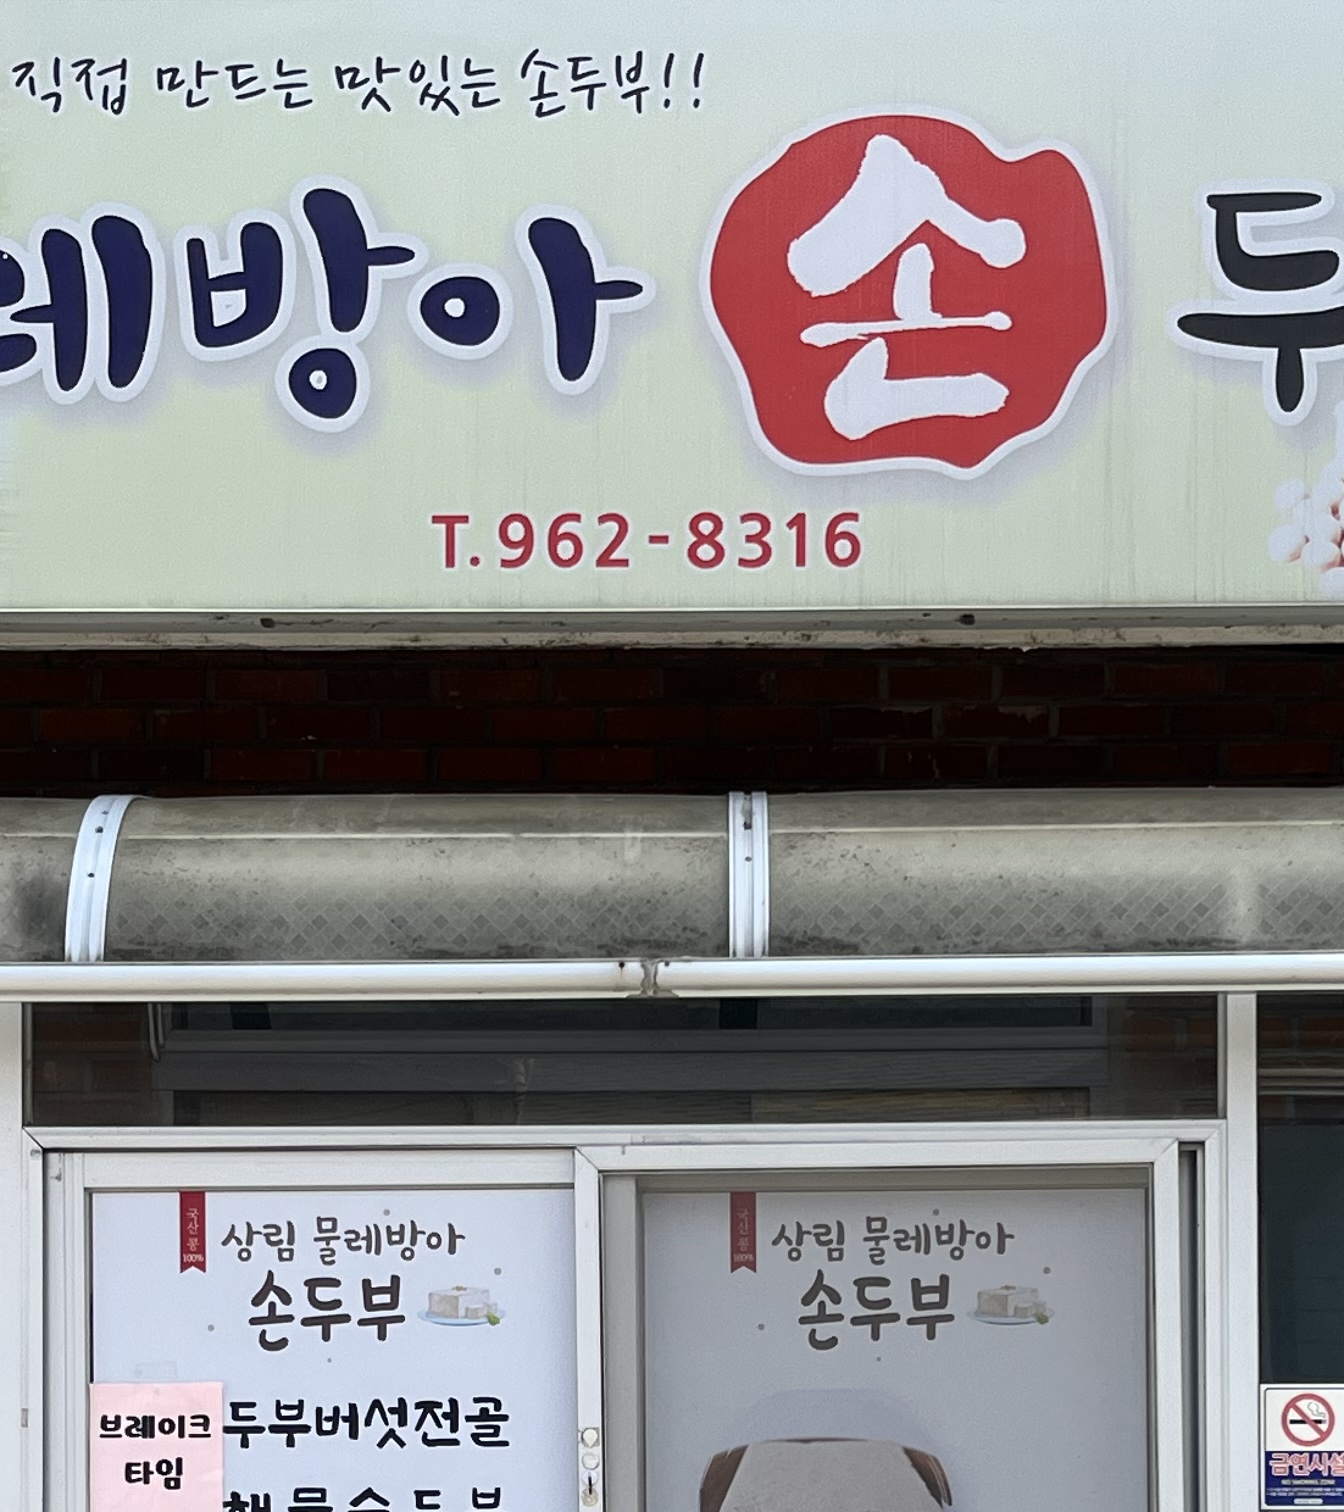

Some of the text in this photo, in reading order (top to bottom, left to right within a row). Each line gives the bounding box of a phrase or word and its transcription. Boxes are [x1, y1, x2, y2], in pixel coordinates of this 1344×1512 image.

[11, 56, 128, 116] 직접
[156, 58, 313, 109] 만드는
[334, 54, 501, 117] 맛있는
[520, 48, 705, 118] 손두부!!
[786, 134, 1026, 441] 손
[432, 511, 862, 569] T.962-8316
[220, 1215, 466, 1266] 상림 물레방아
[771, 1215, 1015, 1266] 상림 물레방아
[248, 1269, 406, 1352] 손두부
[798, 1268, 956, 1351] 손두부
[99, 1414, 212, 1440] 브레이크
[222, 1396, 510, 1449] 두부버섯전골
[124, 1456, 184, 1491] 타임
